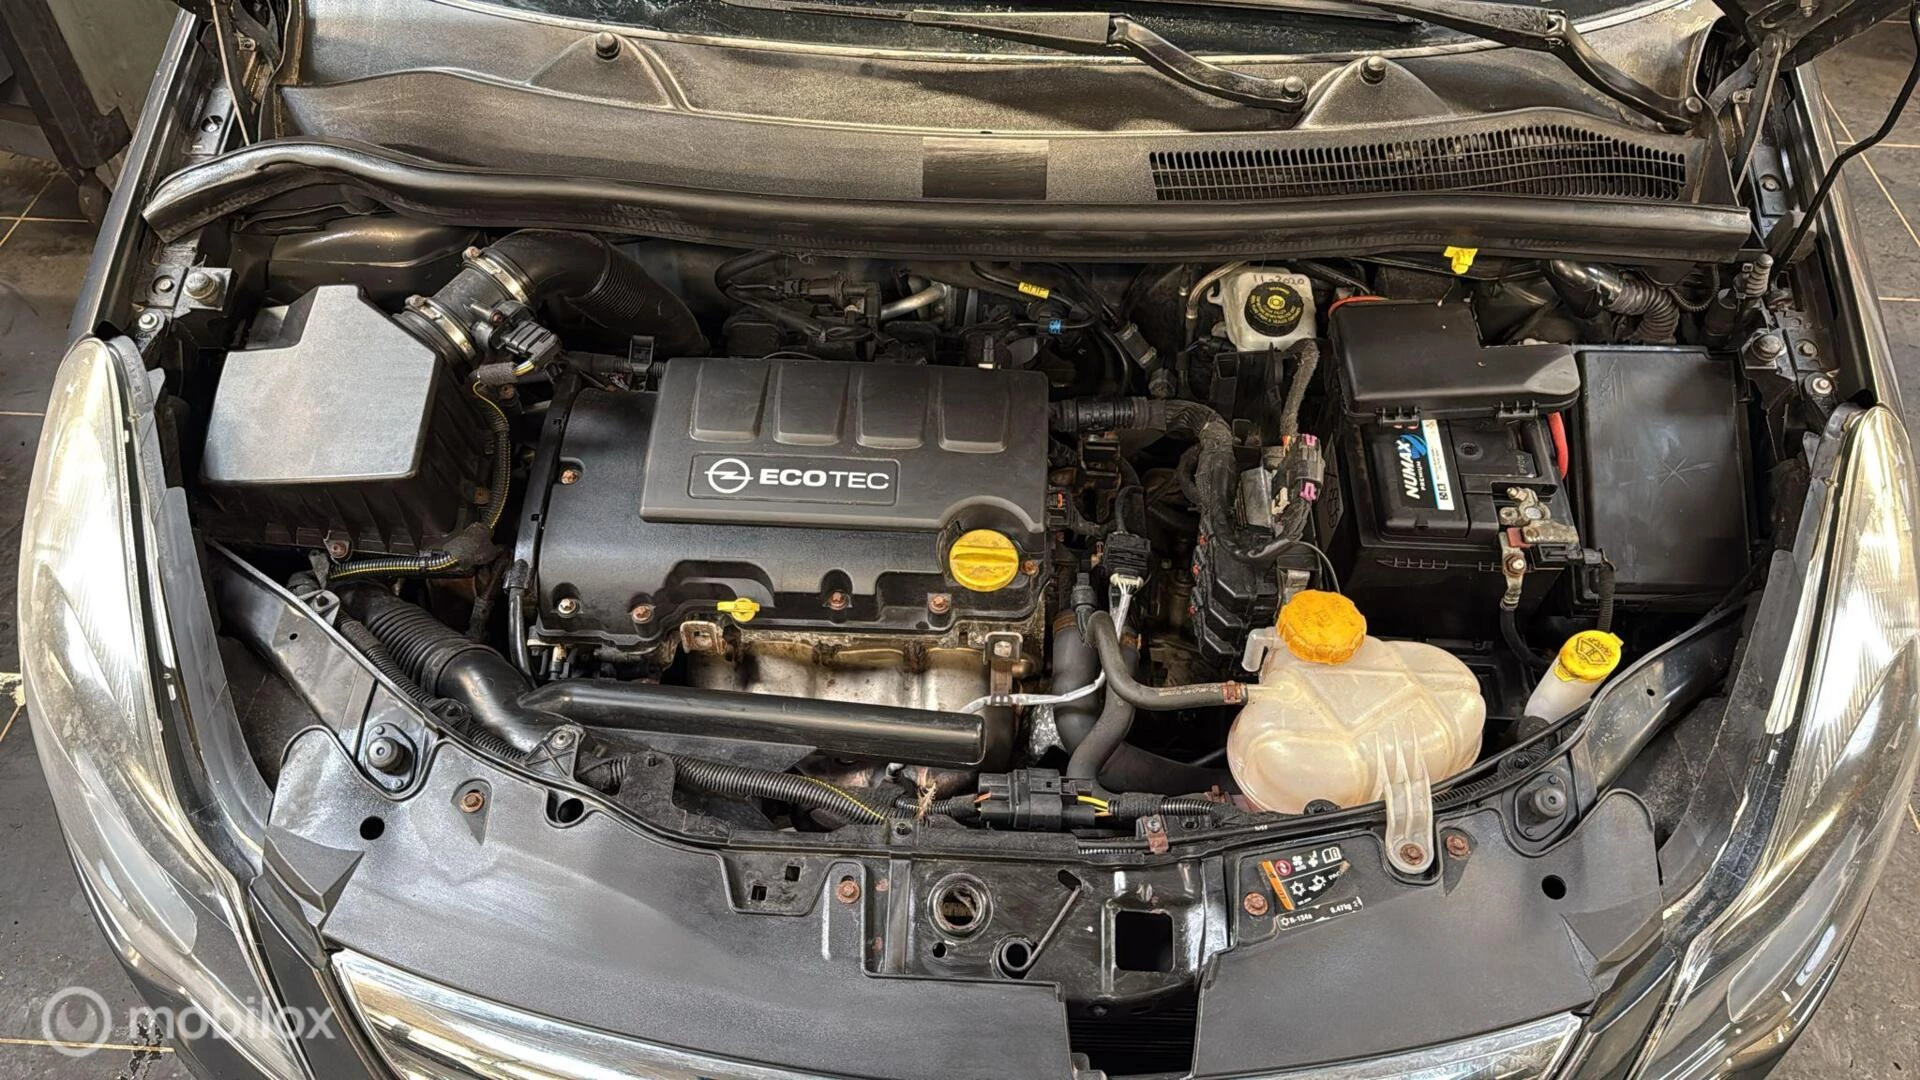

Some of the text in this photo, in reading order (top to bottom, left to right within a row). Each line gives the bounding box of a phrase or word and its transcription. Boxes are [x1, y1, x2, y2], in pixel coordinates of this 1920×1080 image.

[759, 468, 889, 490] ECOTEC
[1395, 440, 1421, 499] NUMAX
[1415, 461, 1427, 491] PREMIUM
